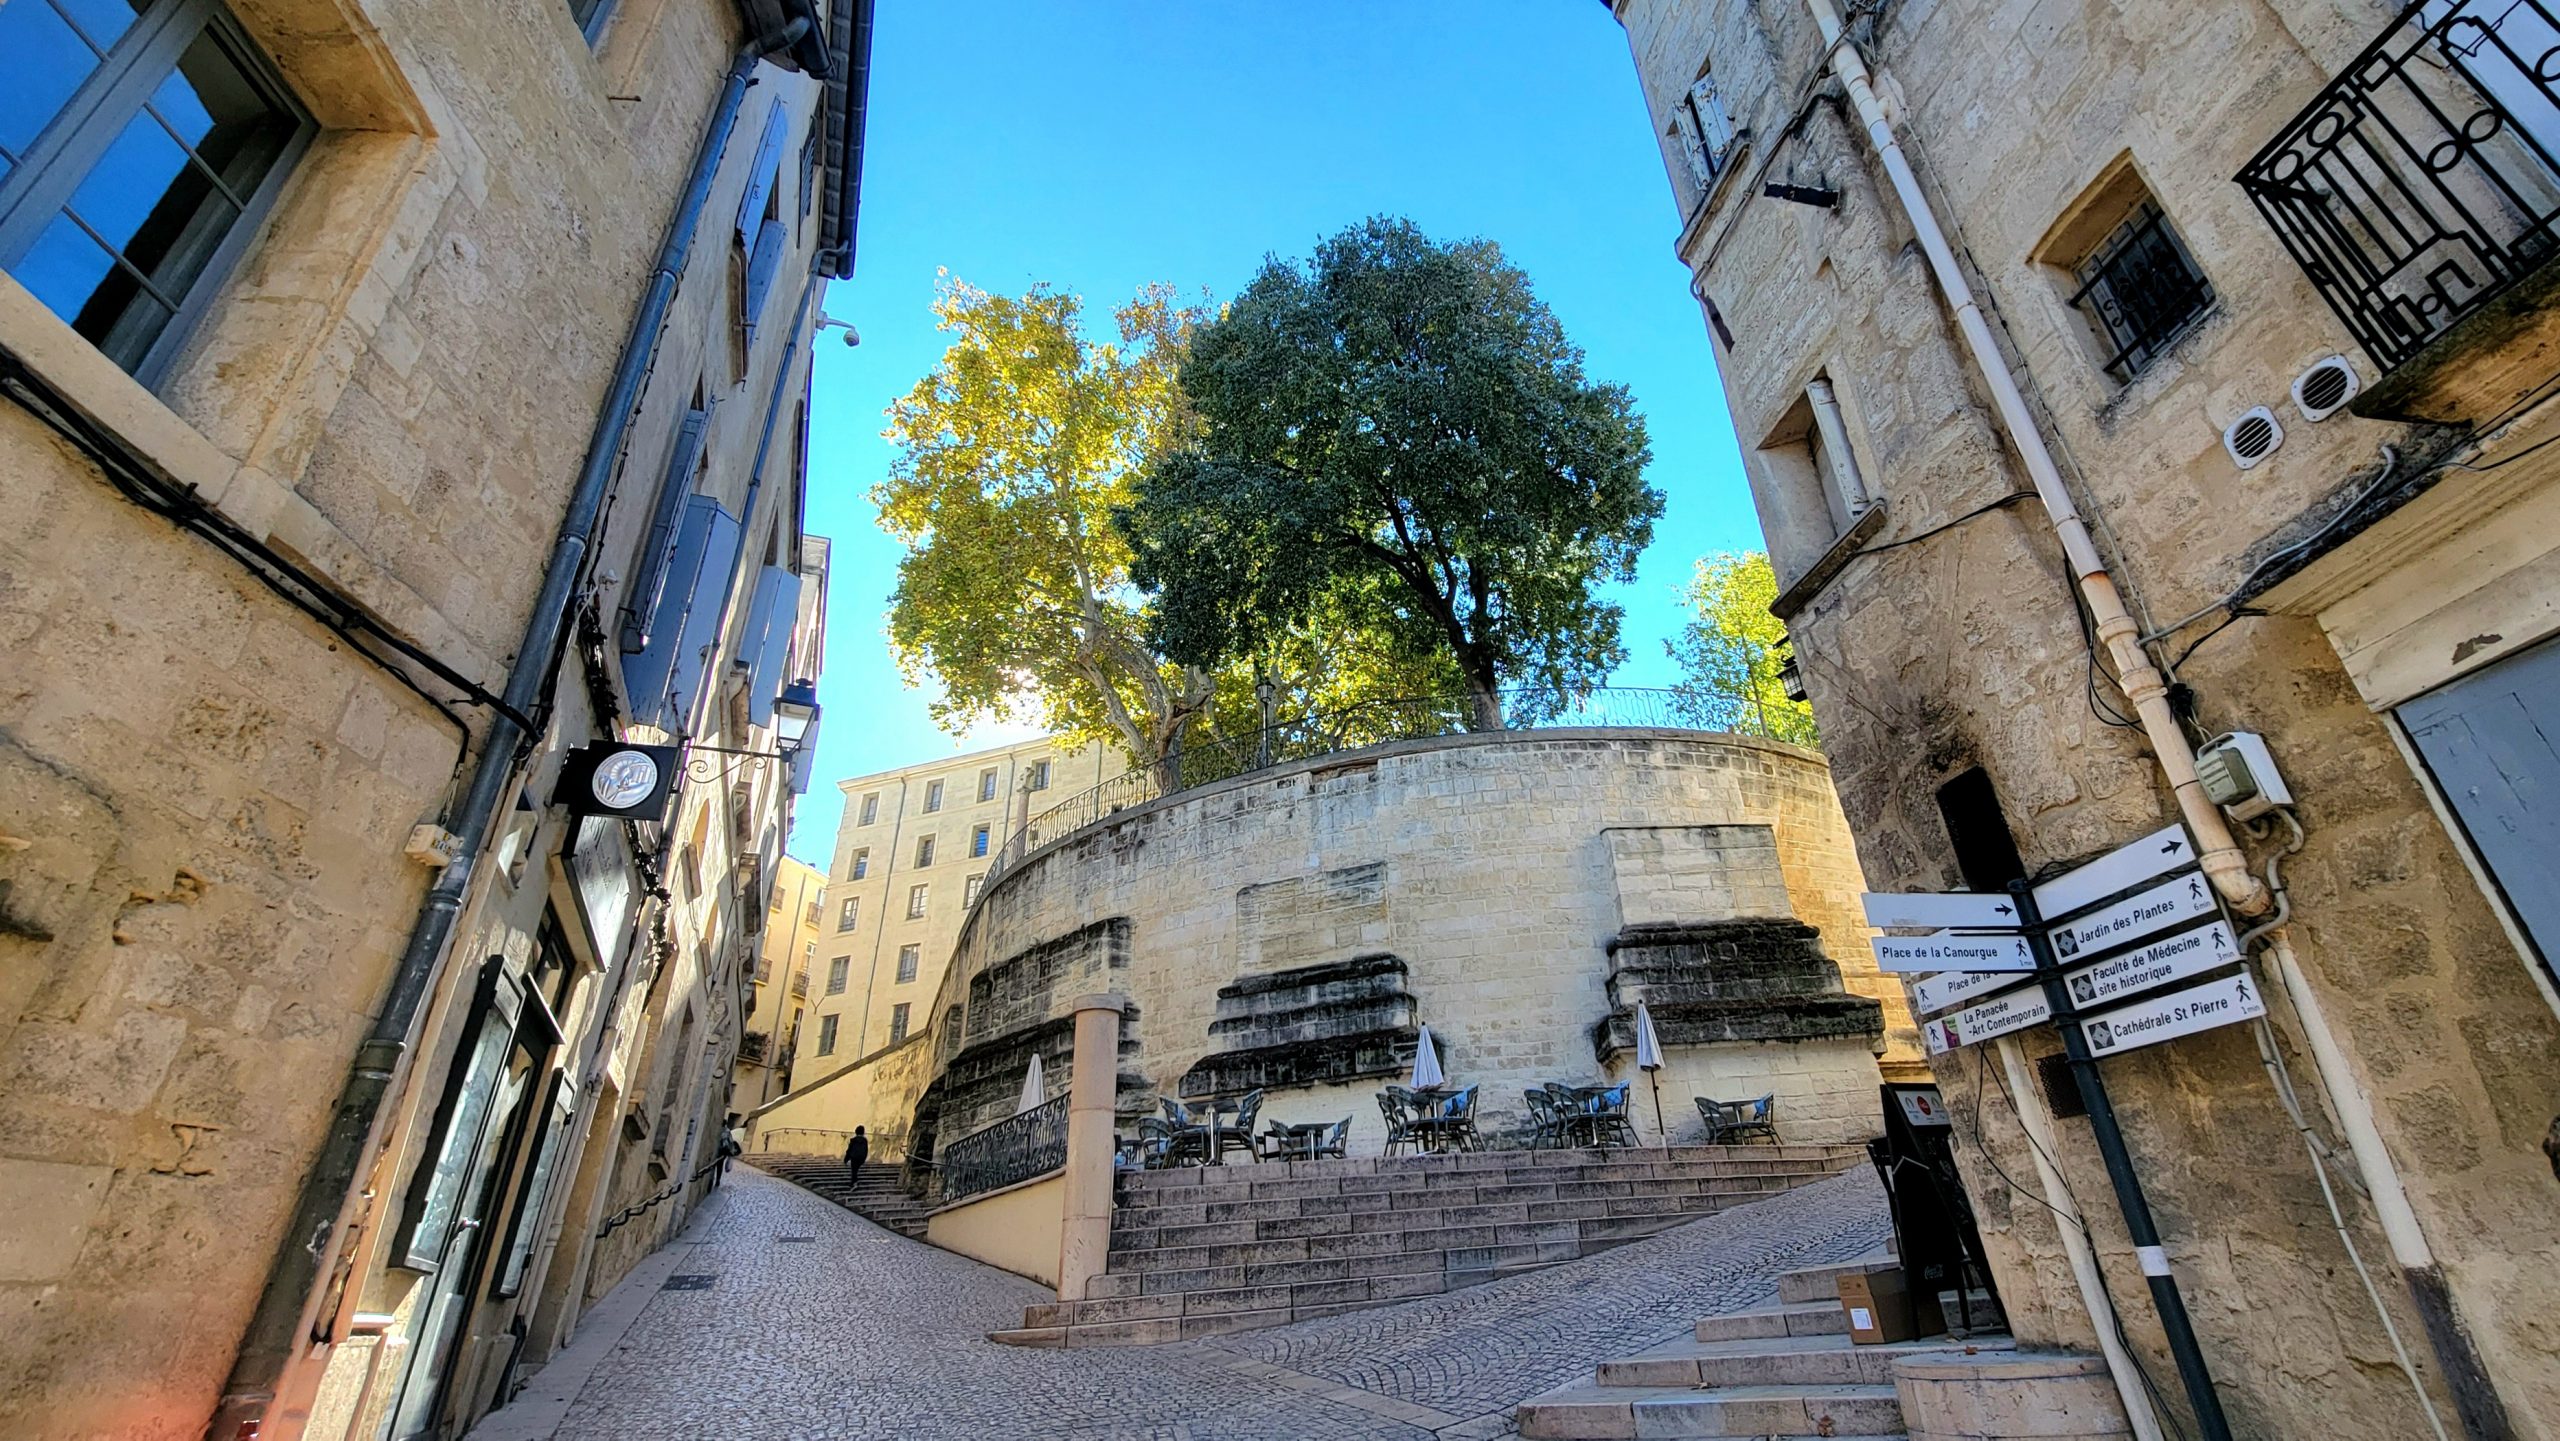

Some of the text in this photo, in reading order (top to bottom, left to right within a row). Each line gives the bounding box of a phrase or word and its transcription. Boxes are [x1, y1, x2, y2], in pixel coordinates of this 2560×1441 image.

[2193, 900, 2211, 911] 6 min
[2079, 900, 2175, 944] Jardin des Plantes
[1882, 946, 1998, 961] Place de la Canourgue
[2092, 936, 2201, 981] Faculté de Médecine
[2216, 950, 2235, 962] 3 min
[1948, 972, 1991, 993] Place de la
[2098, 964, 2172, 996] site historique
[1964, 1012, 1974, 1024] La
[1975, 1001, 2009, 1020] Panacée
[1968, 1005, 2045, 1037] -Art Contemporain
[2114, 998, 2228, 1037] Cathédrale St Pierre
